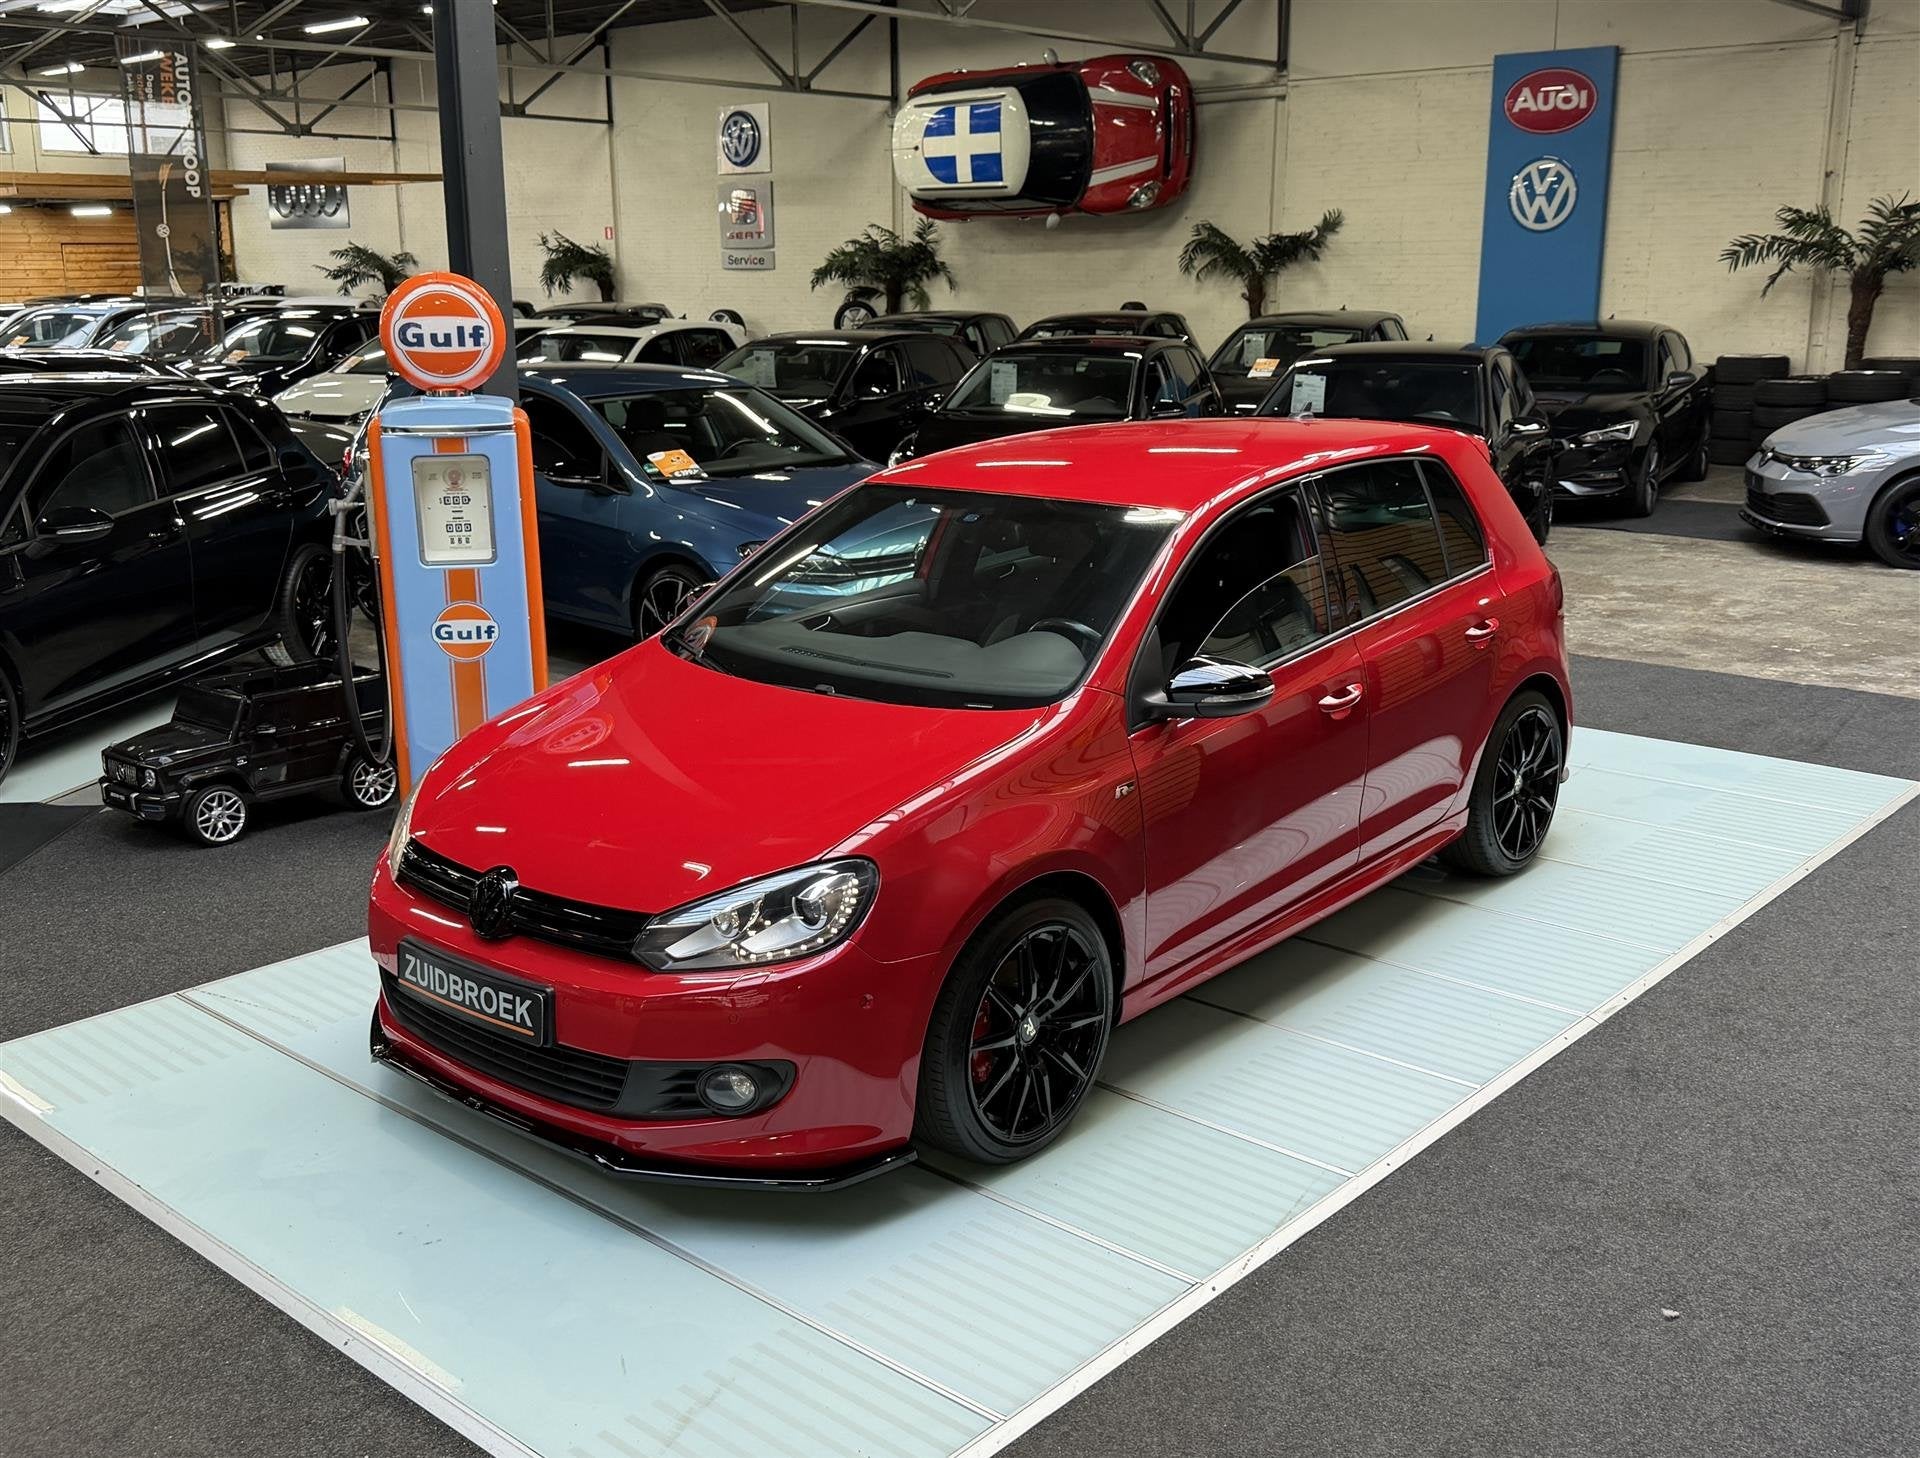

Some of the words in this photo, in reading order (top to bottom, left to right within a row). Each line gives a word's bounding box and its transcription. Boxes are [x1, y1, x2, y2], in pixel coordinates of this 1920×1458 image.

[728, 254, 765, 265] Service
[398, 322, 485, 348] Gulf
[435, 624, 495, 641] Gulf
[404, 953, 533, 1027] ZUIDBROEK
